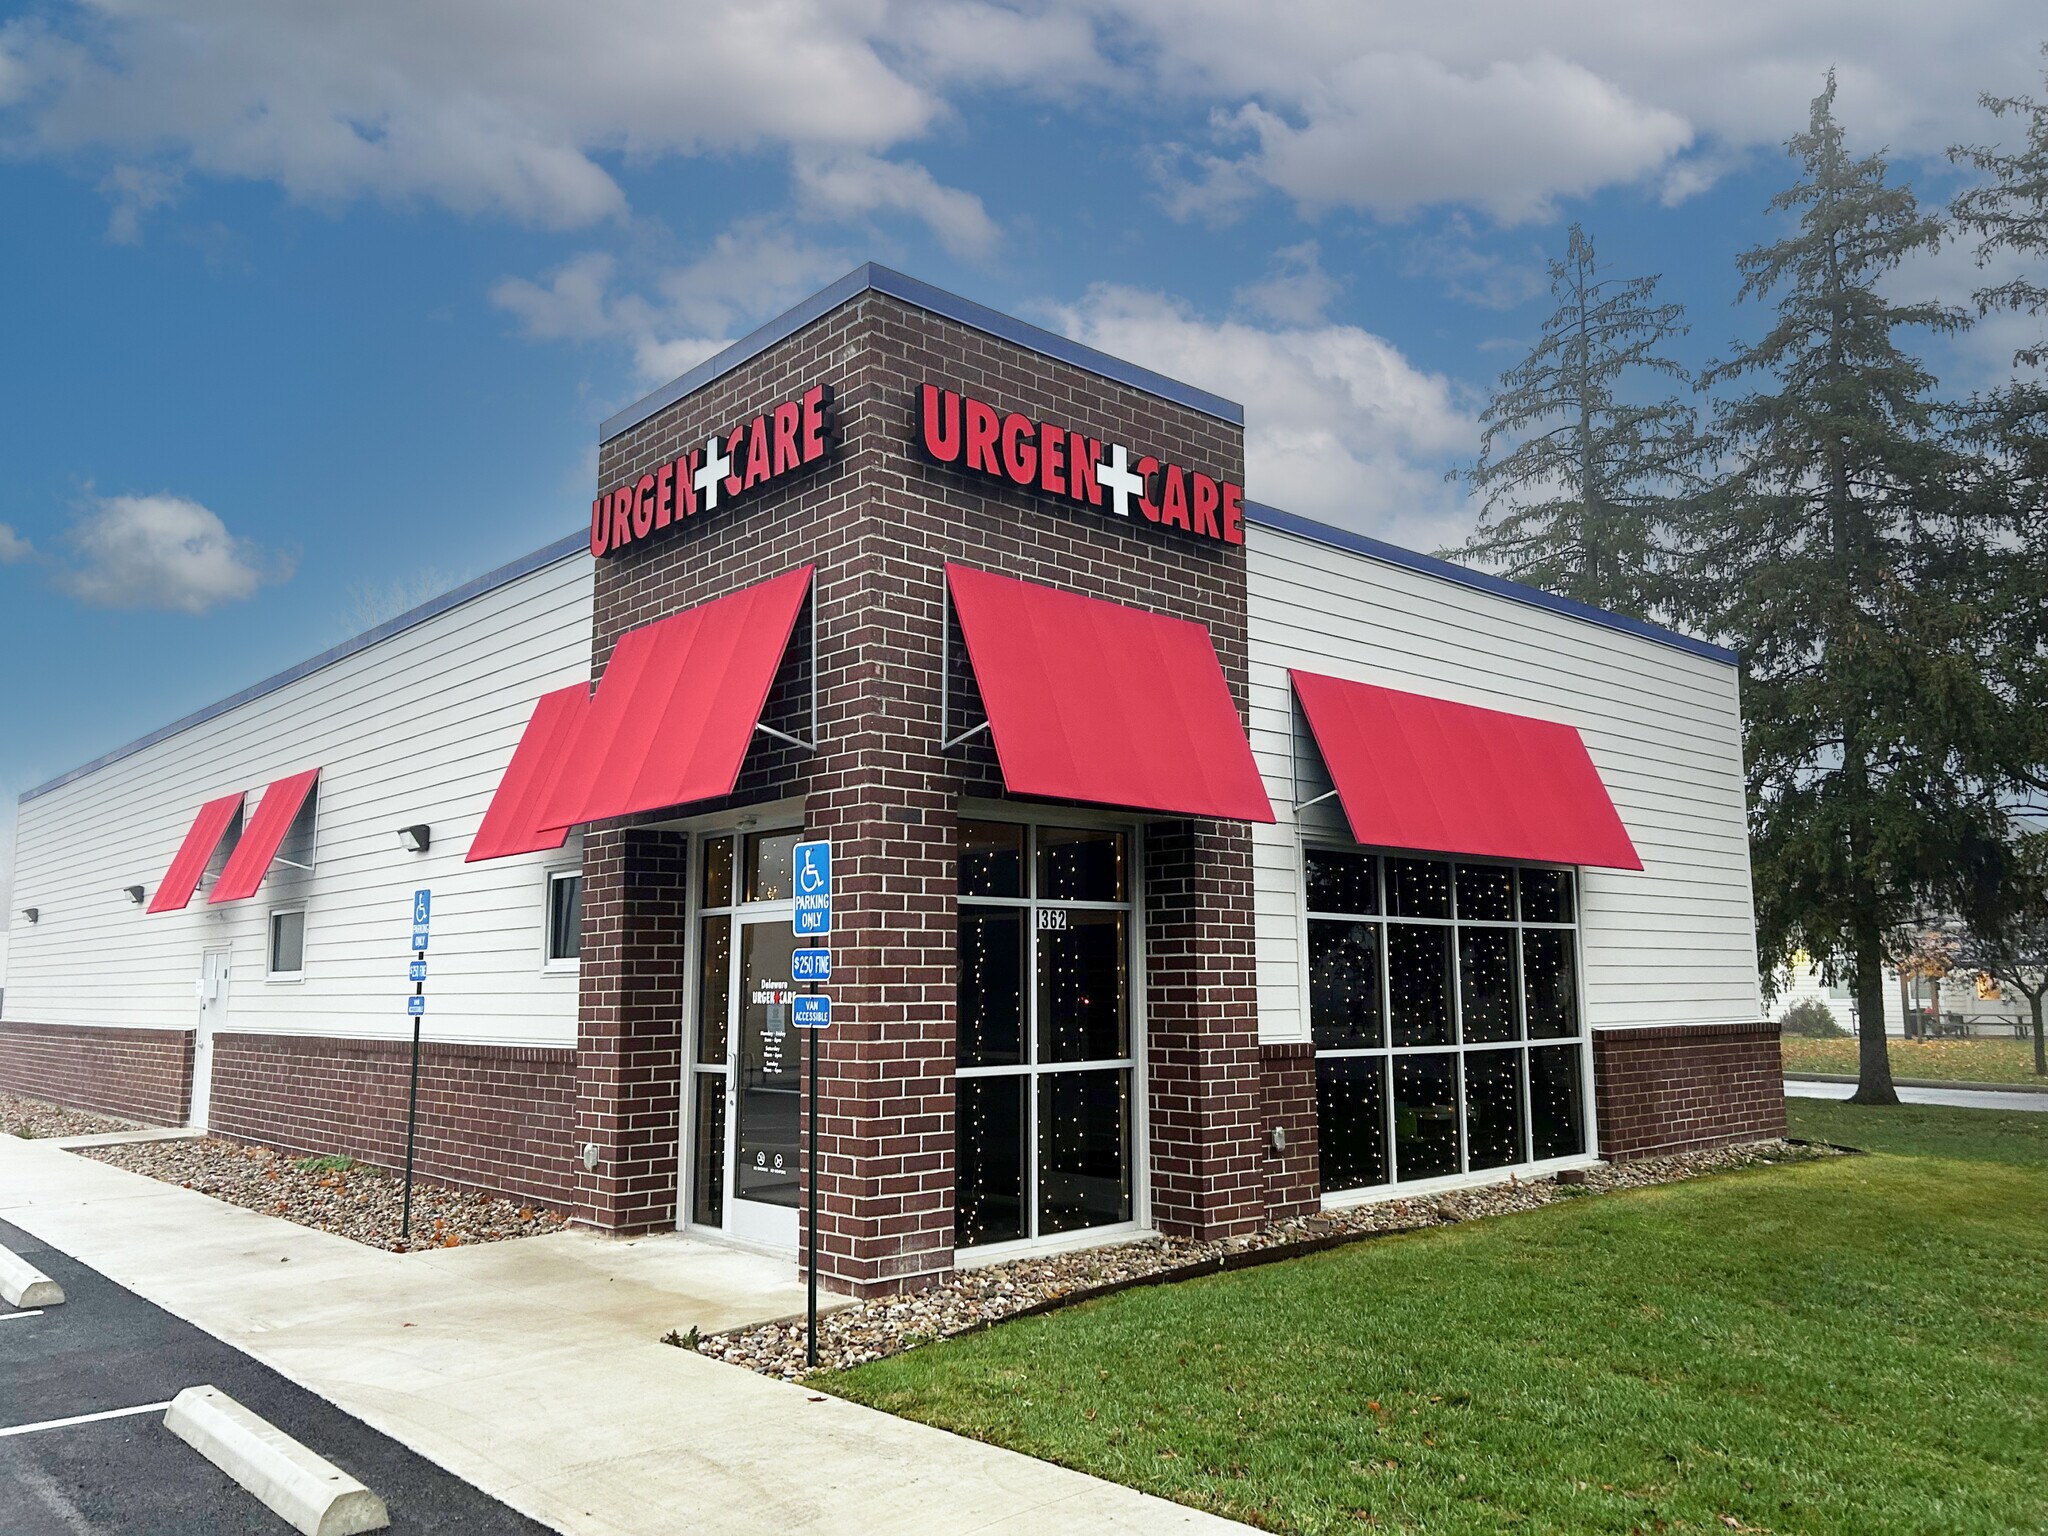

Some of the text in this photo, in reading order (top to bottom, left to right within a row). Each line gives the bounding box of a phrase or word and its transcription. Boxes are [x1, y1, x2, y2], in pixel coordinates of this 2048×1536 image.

[724, 384, 824, 496] CARE
[1137, 455, 1244, 546] CARE
[796, 894, 829, 910] PARKING
[802, 912, 822, 928] ONLY
[1036, 909, 1066, 929] 1362
[794, 956, 830, 974] $250 FINE
[761, 979, 788, 990] Delaware
[805, 1001, 819, 1011] VAN
[795, 1012, 828, 1022] ACCESSIBLE
